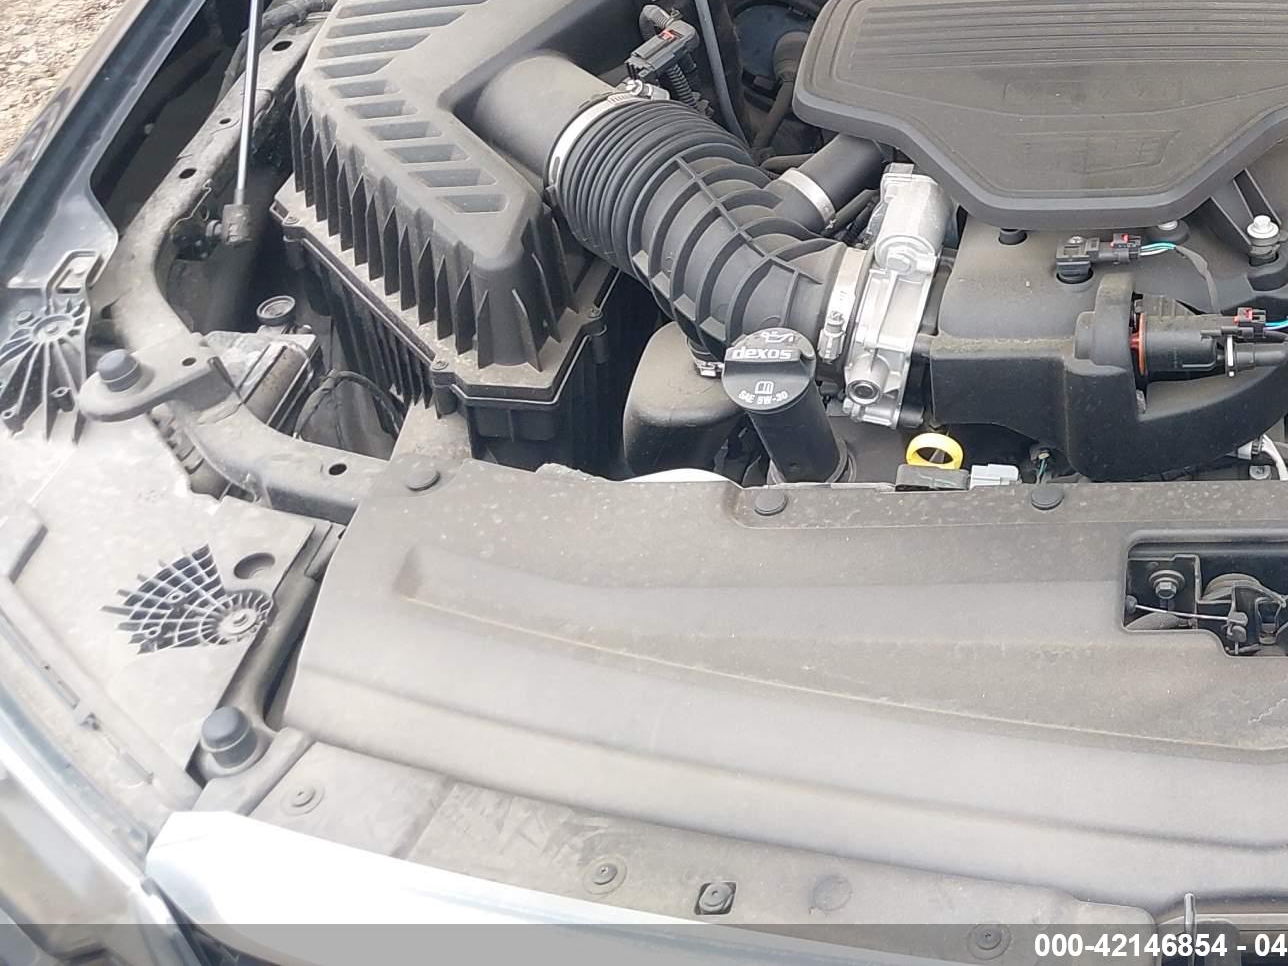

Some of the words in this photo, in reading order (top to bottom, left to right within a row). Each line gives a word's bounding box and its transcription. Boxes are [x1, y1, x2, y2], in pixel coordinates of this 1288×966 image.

[731, 346, 794, 359] dexos
[738, 390, 756, 404] SAE
[756, 390, 789, 405] 5W-30
